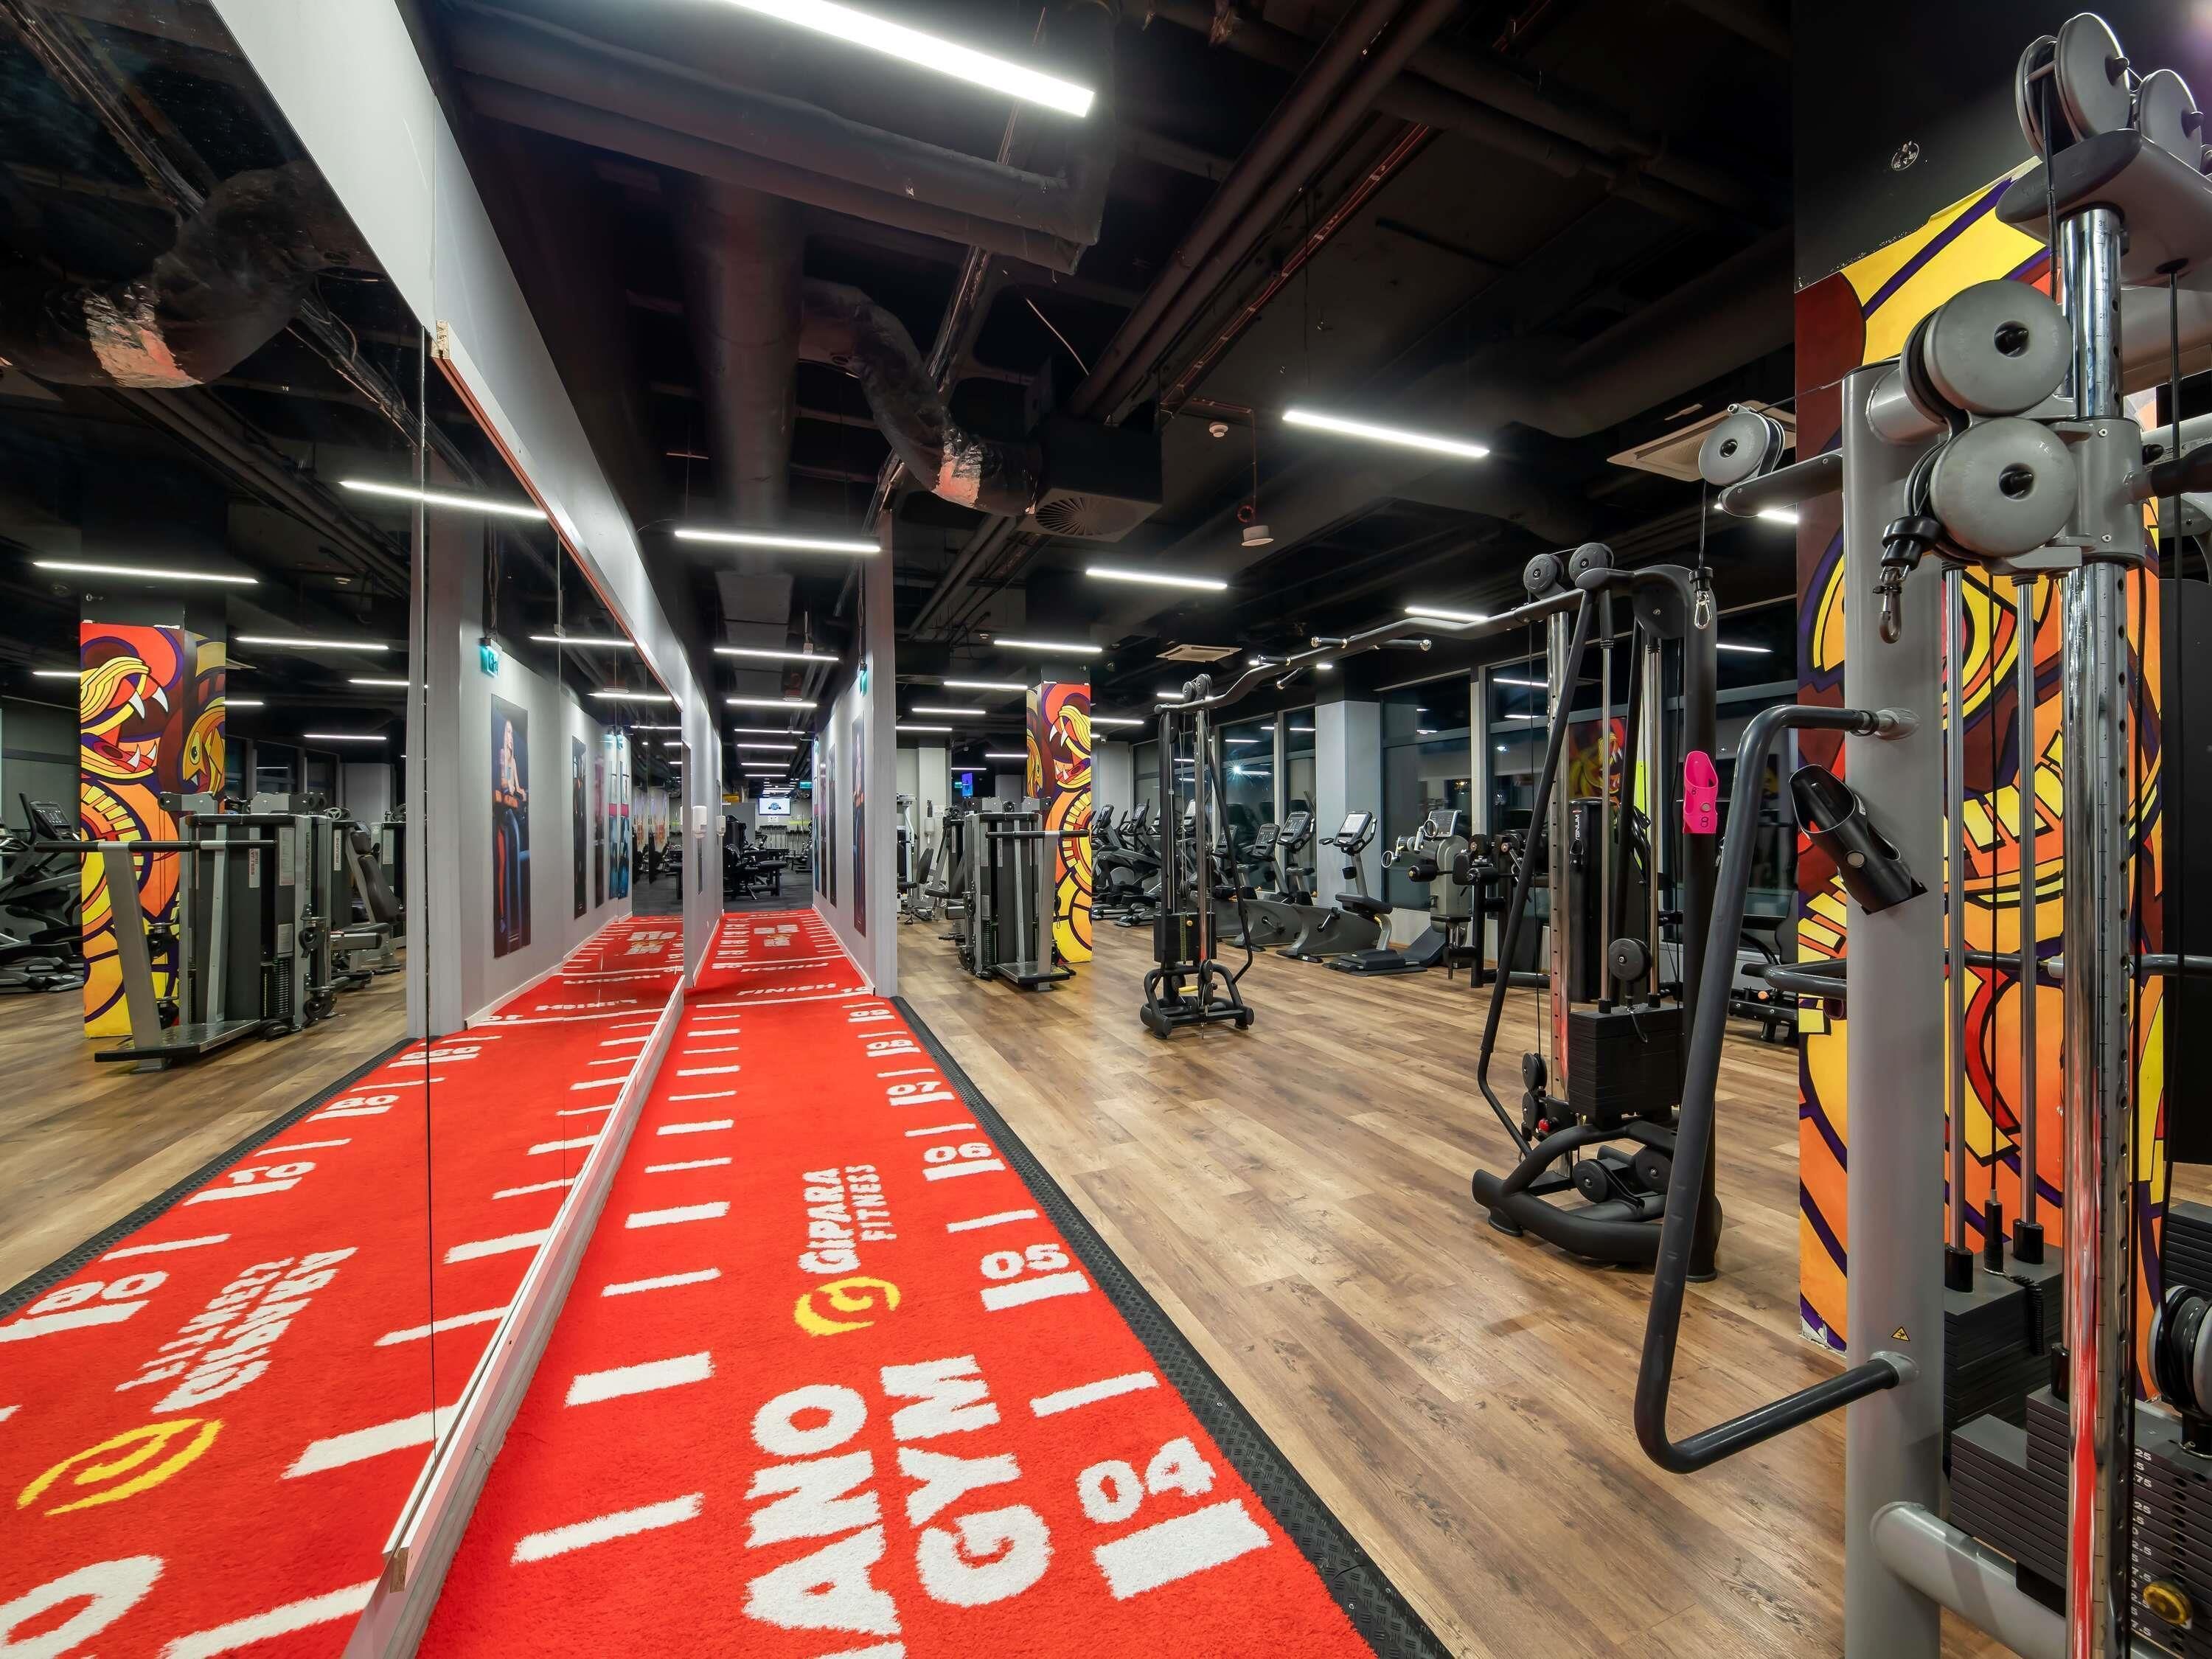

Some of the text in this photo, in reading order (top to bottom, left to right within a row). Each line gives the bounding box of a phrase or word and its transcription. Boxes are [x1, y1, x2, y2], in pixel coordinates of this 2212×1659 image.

[737, 983, 836, 995] FINISH
[849, 1009, 890, 1018] 09
[866, 1040, 914, 1050] 08
[886, 1081, 942, 1096] 07
[924, 1142, 993, 1164] 06
[797, 1168, 861, 1274] GIPARA
[844, 1164, 897, 1242] FITNESS
[980, 1243, 1071, 1280] 05
[880, 1354, 1054, 1608] GYM
[1073, 1436, 1217, 1525] 04
[742, 1384, 908, 1659] ANO
